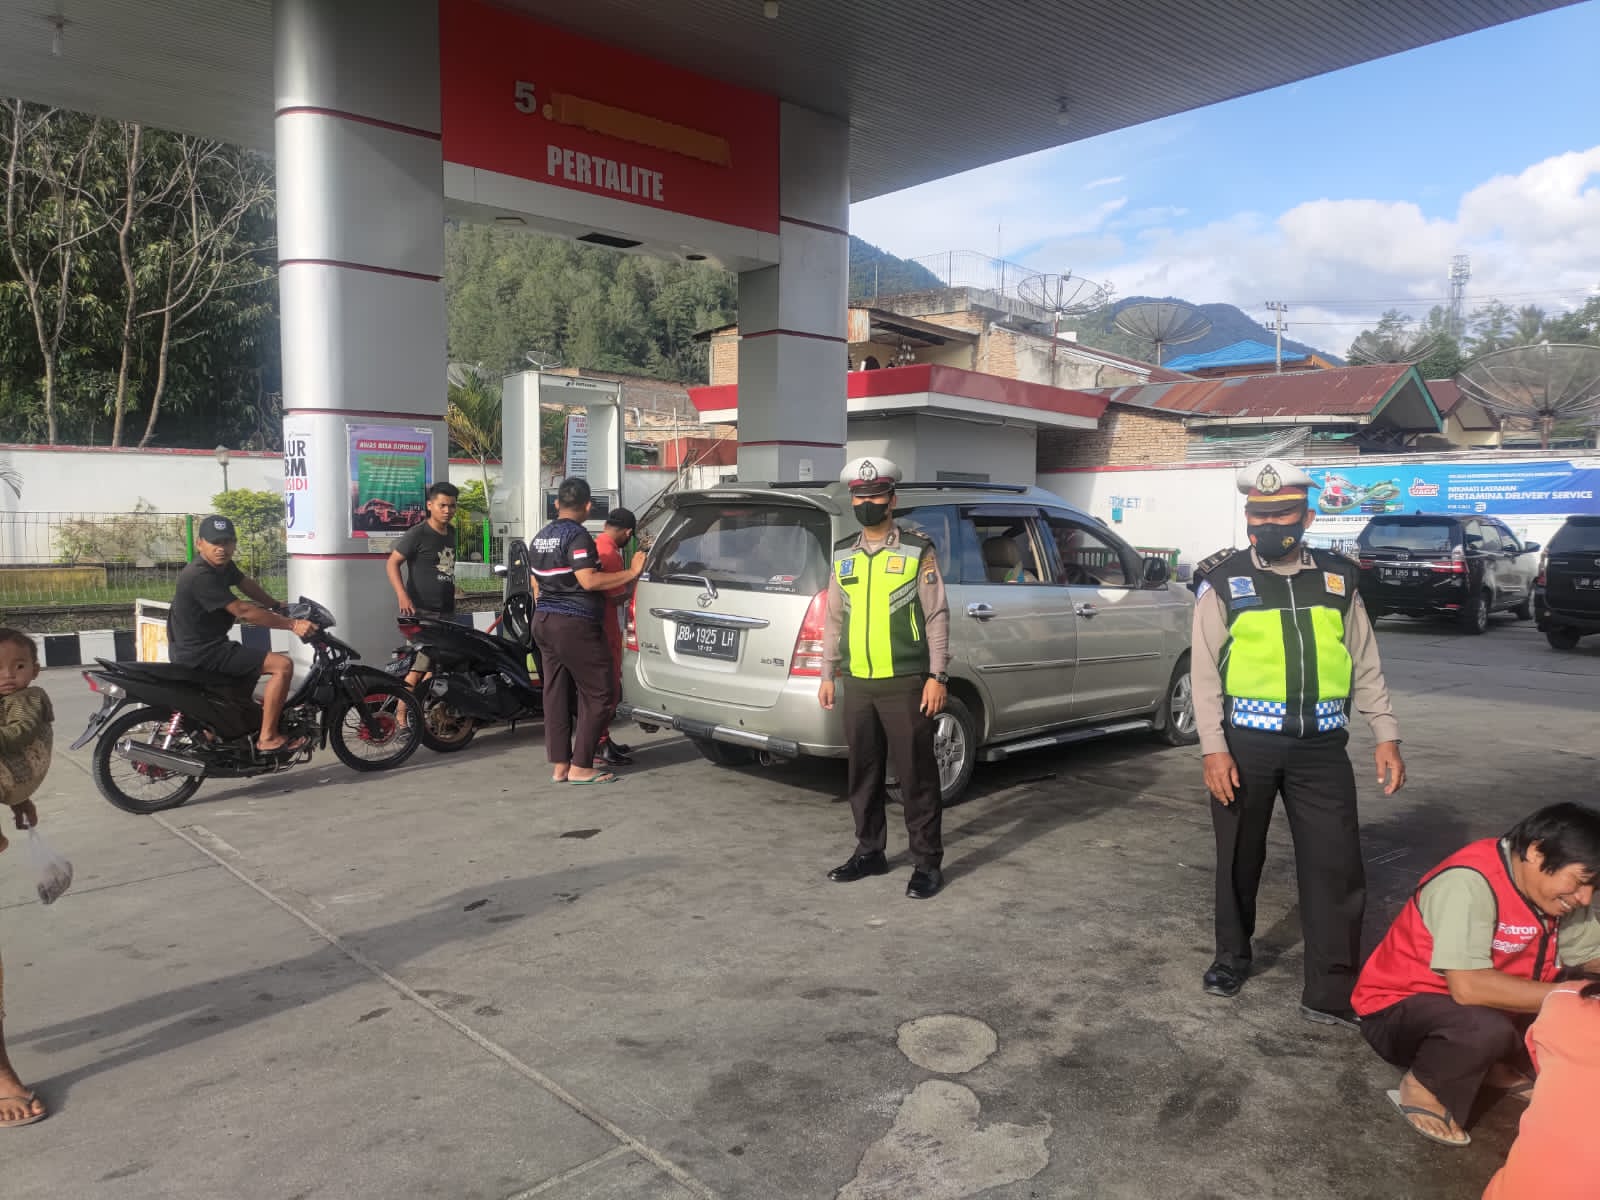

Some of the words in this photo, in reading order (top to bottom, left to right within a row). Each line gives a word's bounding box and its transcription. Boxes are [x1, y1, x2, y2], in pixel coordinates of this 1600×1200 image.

[546, 145, 665, 202] PERTALITE
[1447, 492, 1503, 500] PERTAMINA
[1504, 491, 1550, 500] DELIVERY
[1551, 490, 1593, 499] SERVICE
[696, 628, 718, 645] 1925
[721, 631, 735, 648] LH
